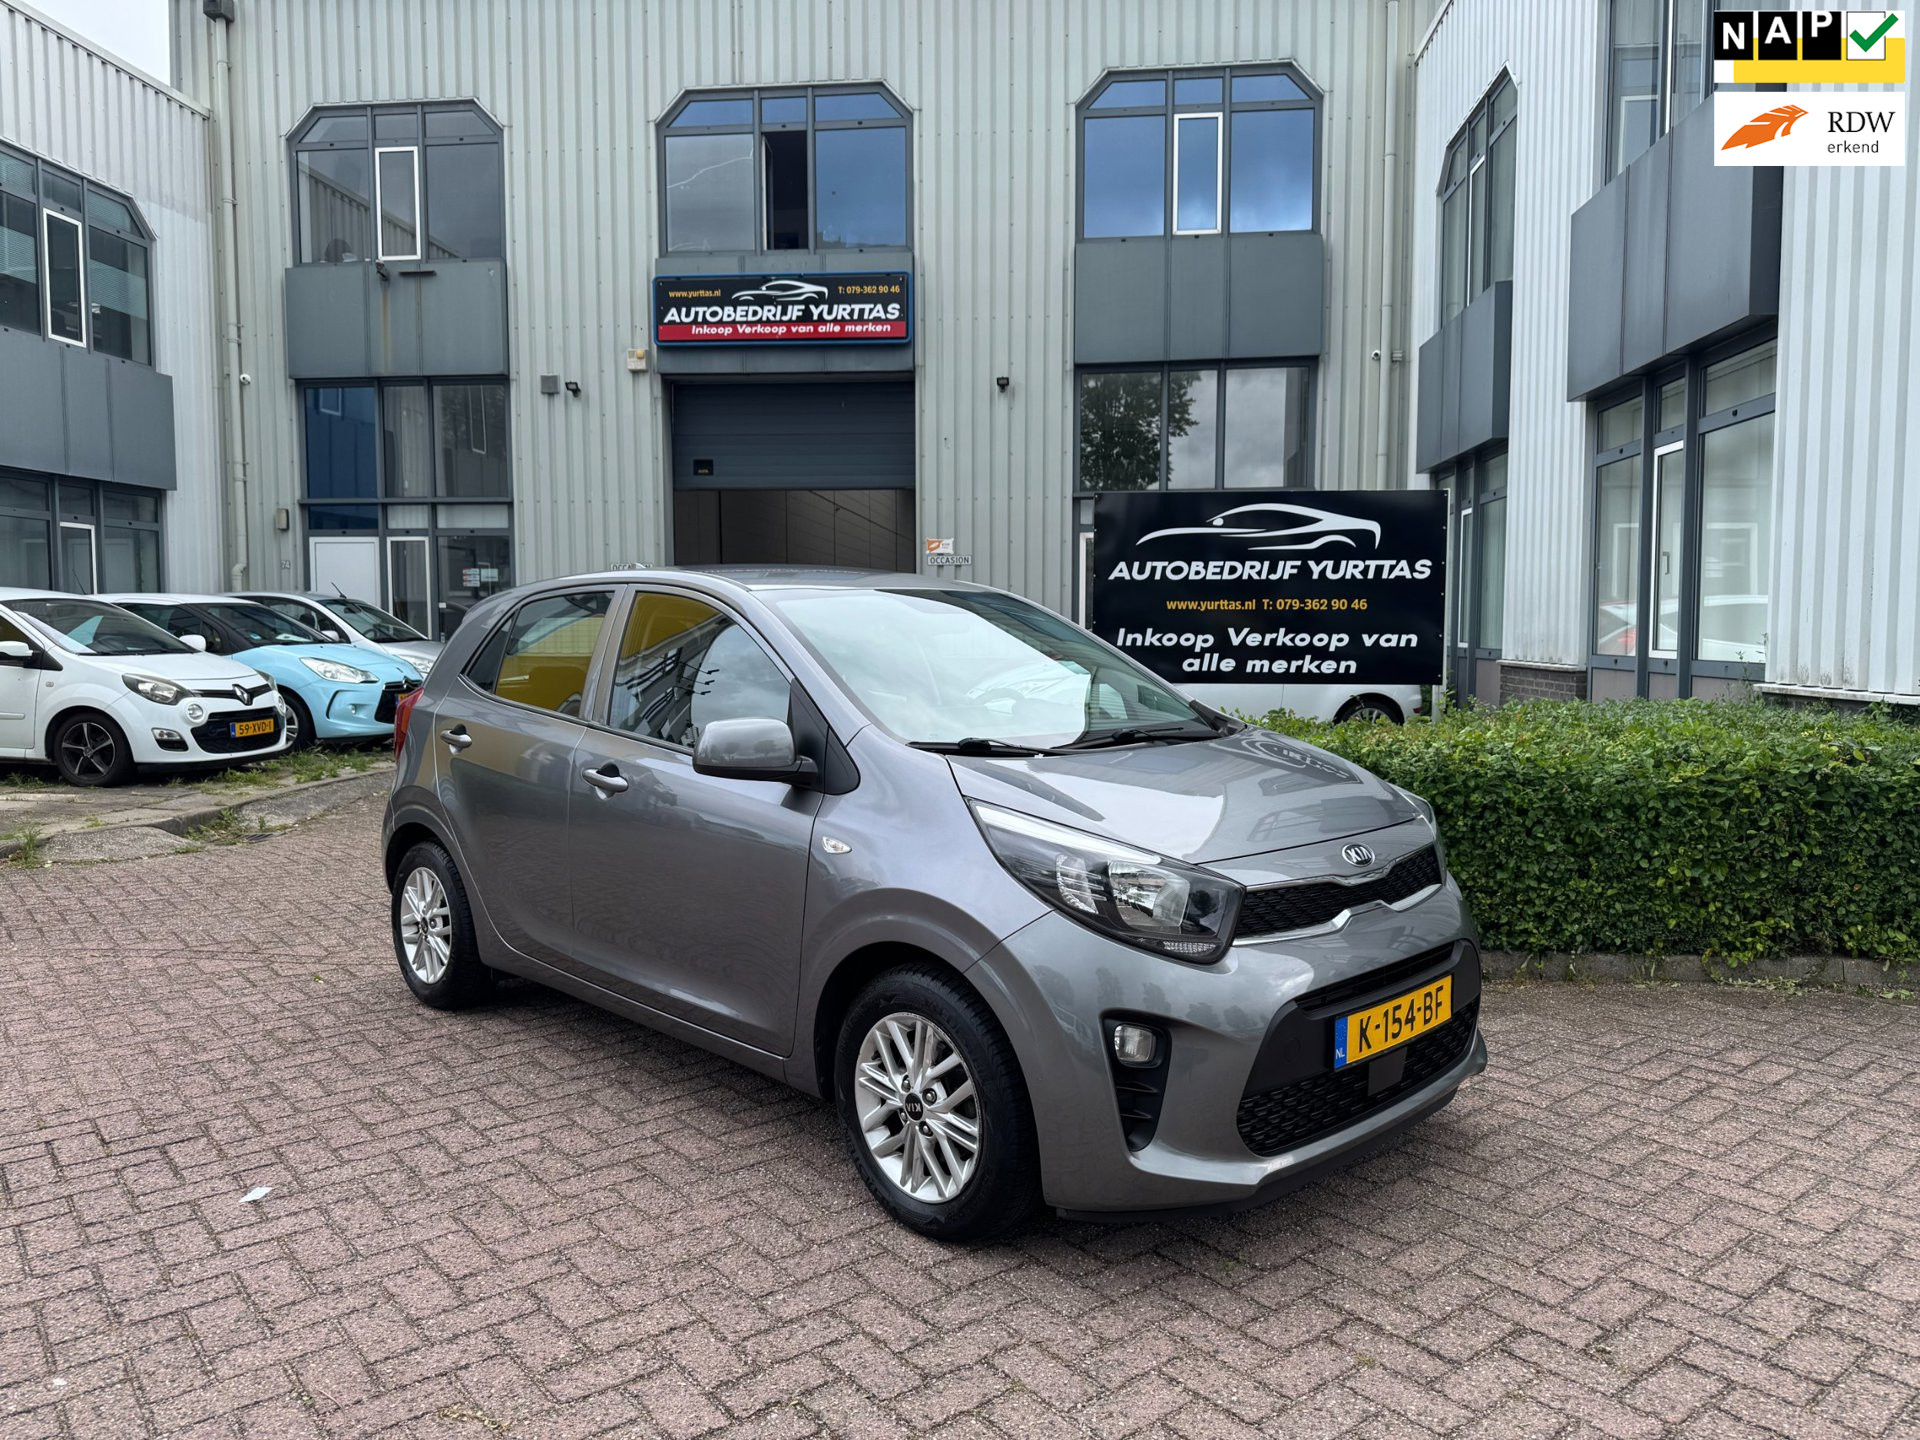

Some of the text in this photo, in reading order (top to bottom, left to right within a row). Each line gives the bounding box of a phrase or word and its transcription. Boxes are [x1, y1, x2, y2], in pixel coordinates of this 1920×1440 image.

[668, 289, 721, 298] www.yurttas.nl
[838, 285, 900, 294] T: 079-362 90 46
[664, 303, 900, 323] AUTOBEDRIJF YURTTAS
[692, 325, 732, 336] Inkoop
[737, 324, 787, 335] Verkoop
[818, 323, 841, 333] alle
[845, 323, 891, 332] merken
[930, 556, 969, 564] OCCASION
[1108, 559, 1433, 580] AUTOBEDRIJF YURTTAS
[1166, 599, 1368, 611] www.yurttas.nl T: 079-362 90 46
[1116, 627, 1418, 652] Inkoop Verkoop van
[1182, 653, 1357, 674] alle merken
[1346, 846, 1371, 862] KIA
[1359, 985, 1444, 1053] K-154-BF
[1335, 1048, 1345, 1060] NL
